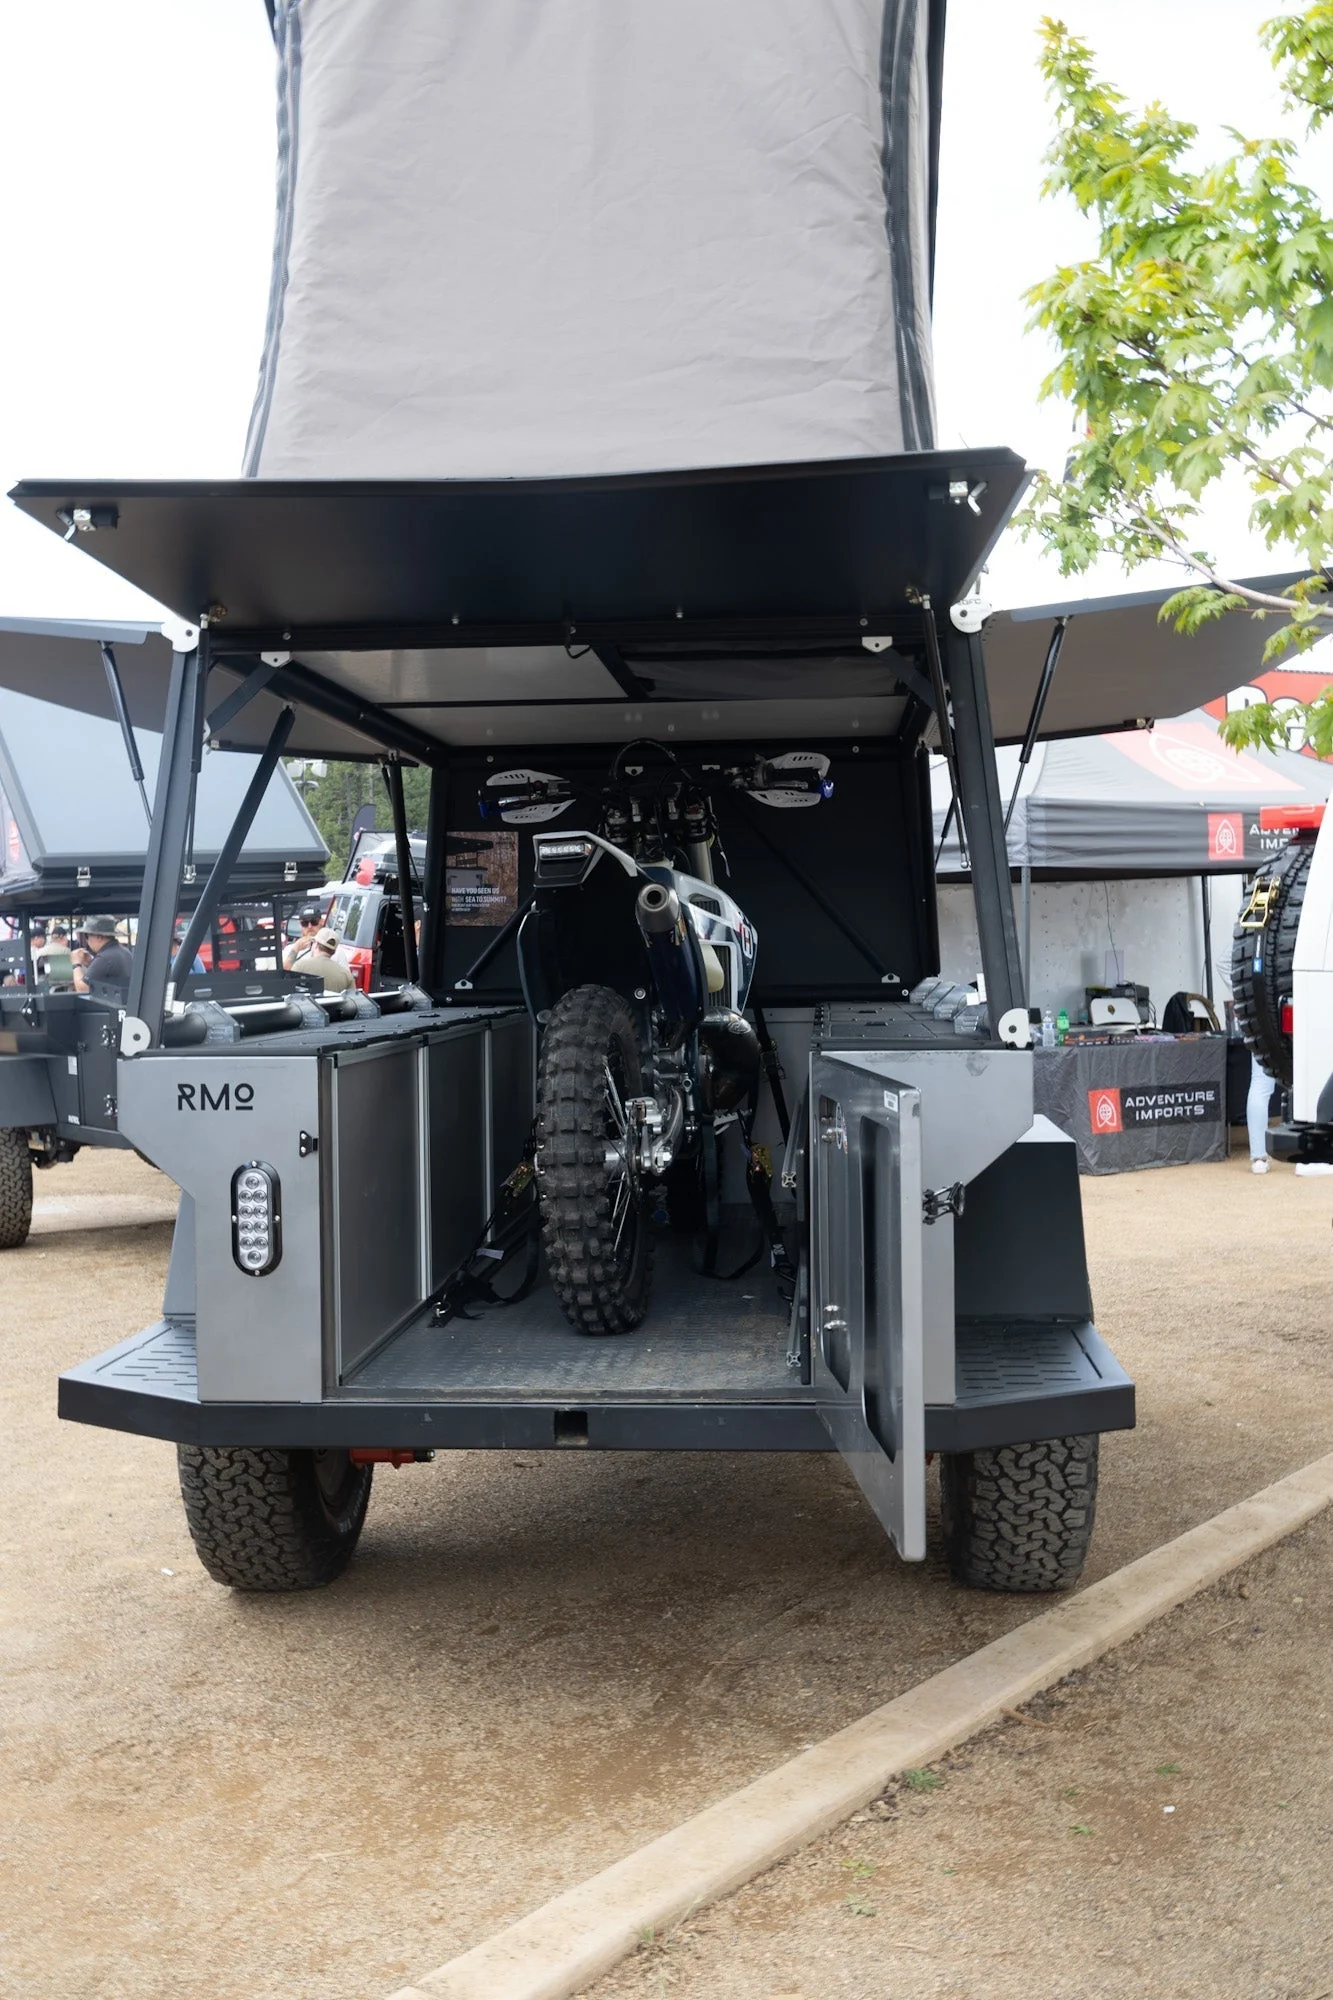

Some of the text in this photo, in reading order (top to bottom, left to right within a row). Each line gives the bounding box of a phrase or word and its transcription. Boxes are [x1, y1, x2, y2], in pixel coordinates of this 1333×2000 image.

[466, 895, 476, 903] SEA
[476, 895, 484, 903] TO
[1125, 1090, 1215, 1108] ADVENTURE
[1135, 1104, 1205, 1121] IMPORTS
